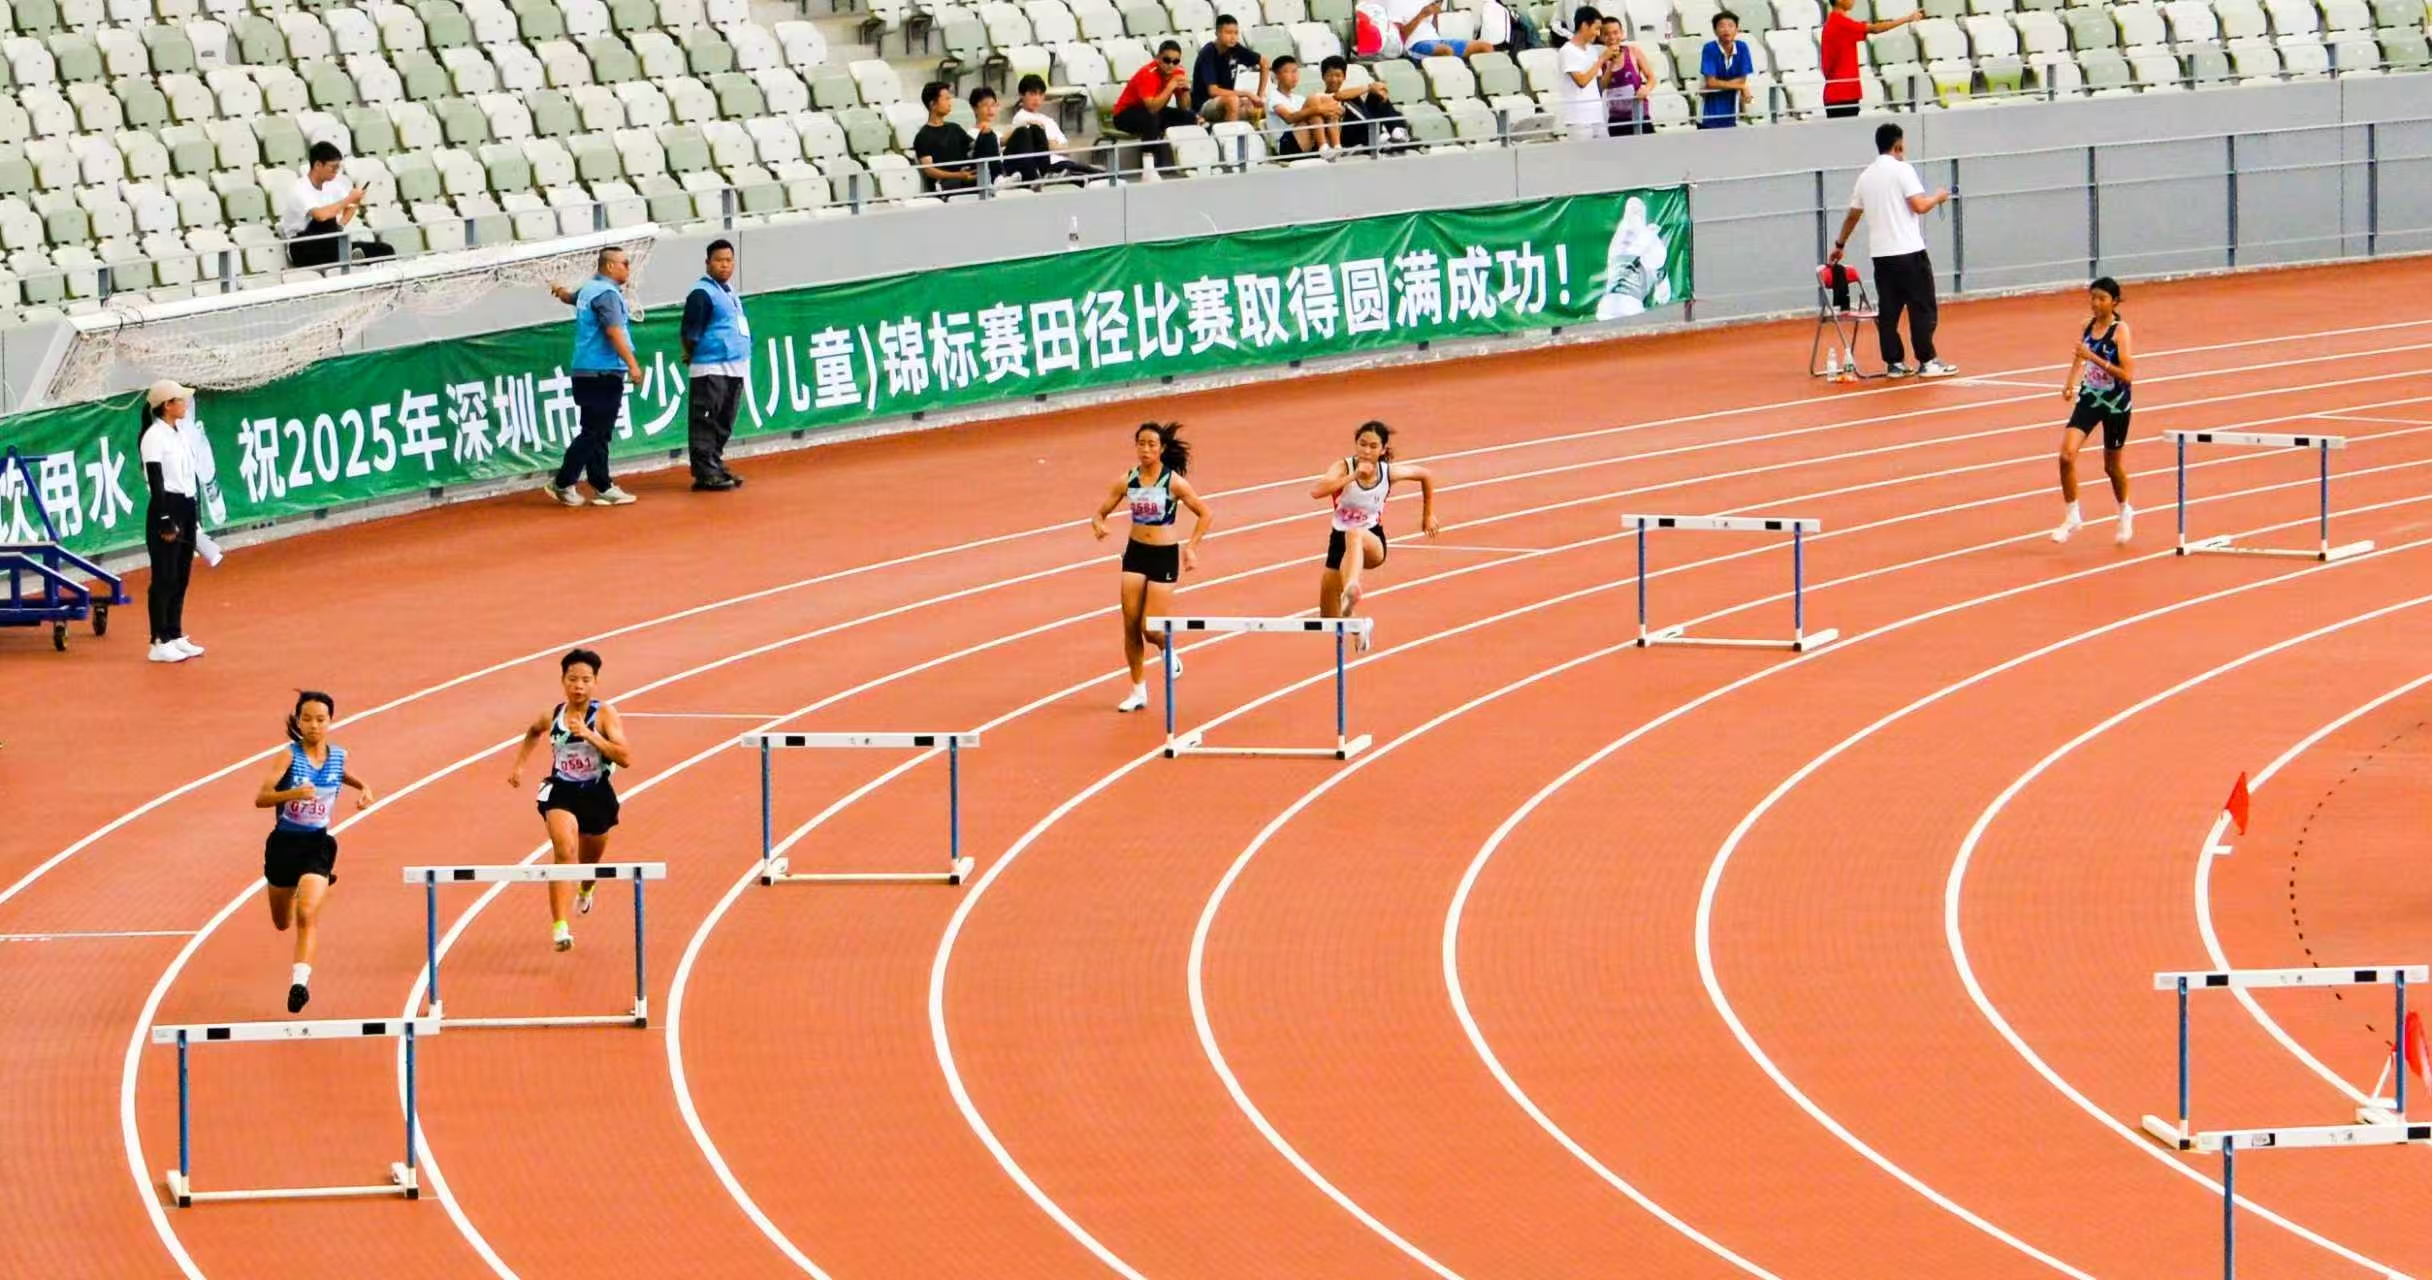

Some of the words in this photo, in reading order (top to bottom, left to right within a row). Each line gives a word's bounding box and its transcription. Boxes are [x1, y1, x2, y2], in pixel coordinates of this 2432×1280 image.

[238, 241, 1571, 504] 祝2025年深圳市少(儿童)锦标赛田径比赛取得圆满成功!
[290, 799, 327, 816] 0739
